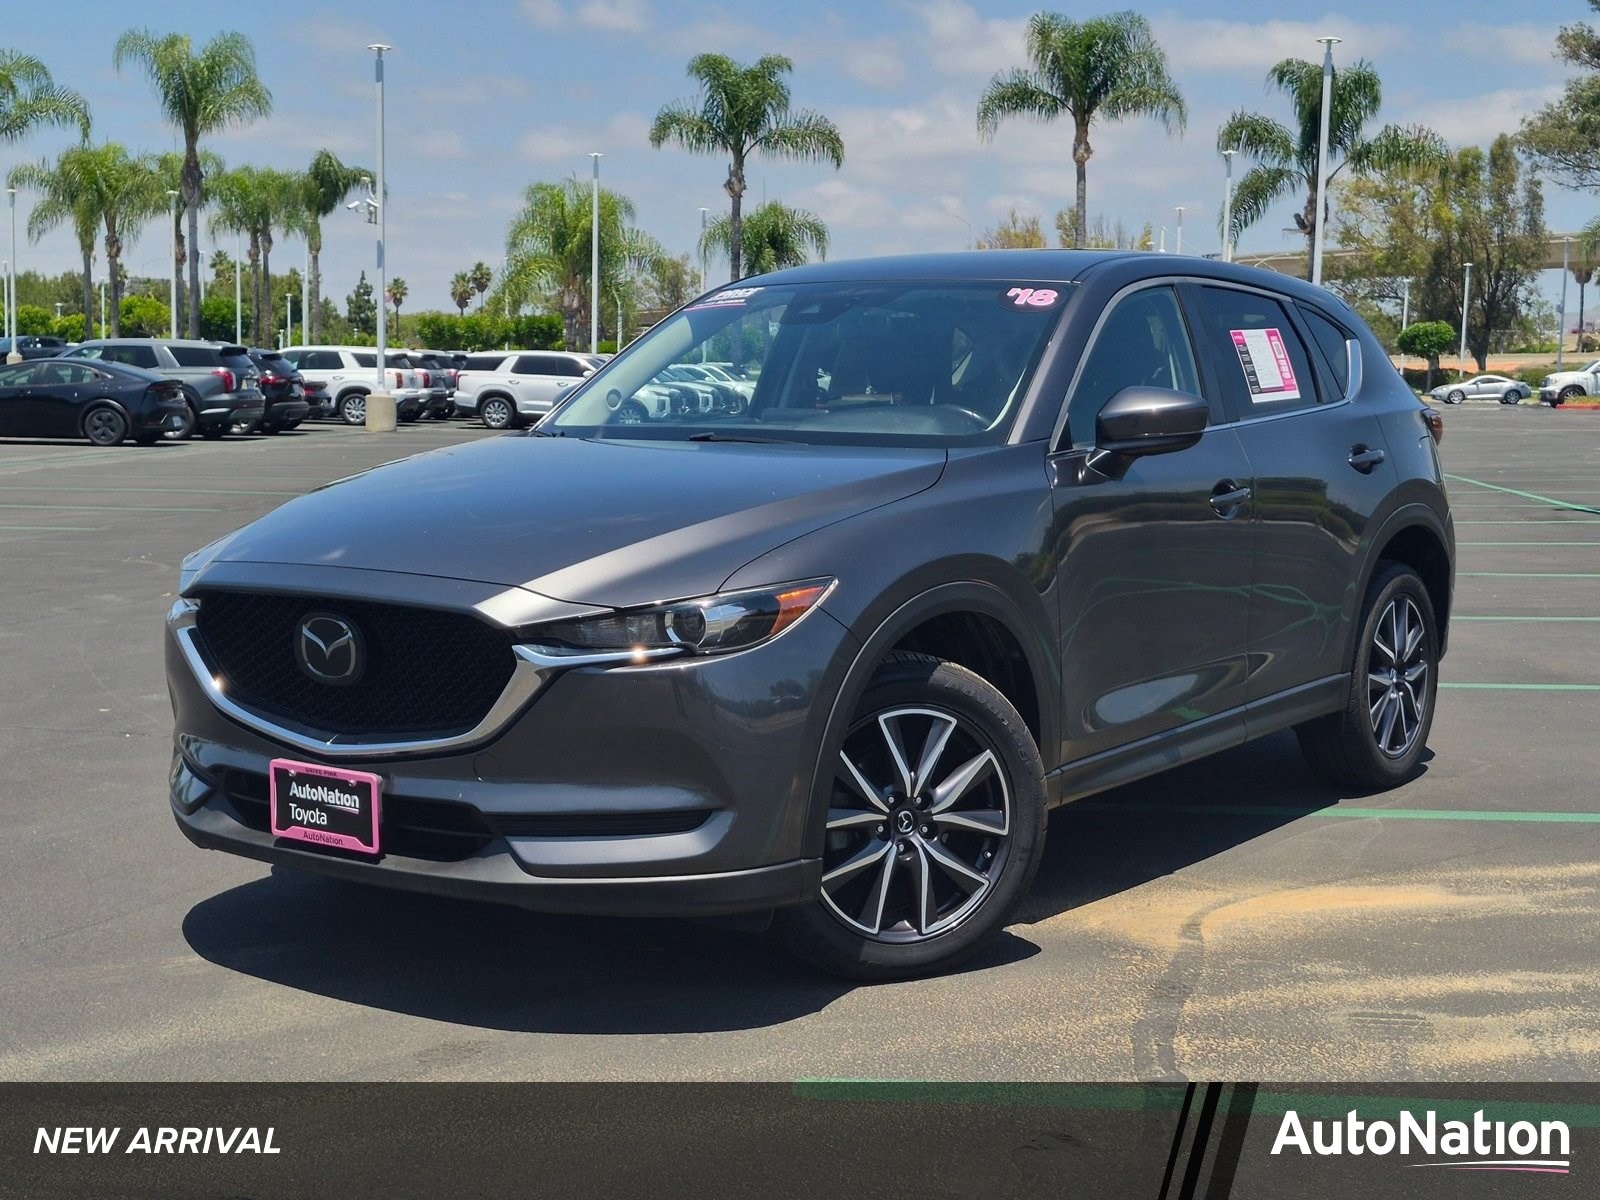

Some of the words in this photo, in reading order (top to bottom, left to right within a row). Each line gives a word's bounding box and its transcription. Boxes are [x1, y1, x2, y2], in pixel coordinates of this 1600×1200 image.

[289, 781, 360, 809] AutoNation
[289, 803, 328, 826] Toyota
[303, 831, 344, 847] AutoNation
